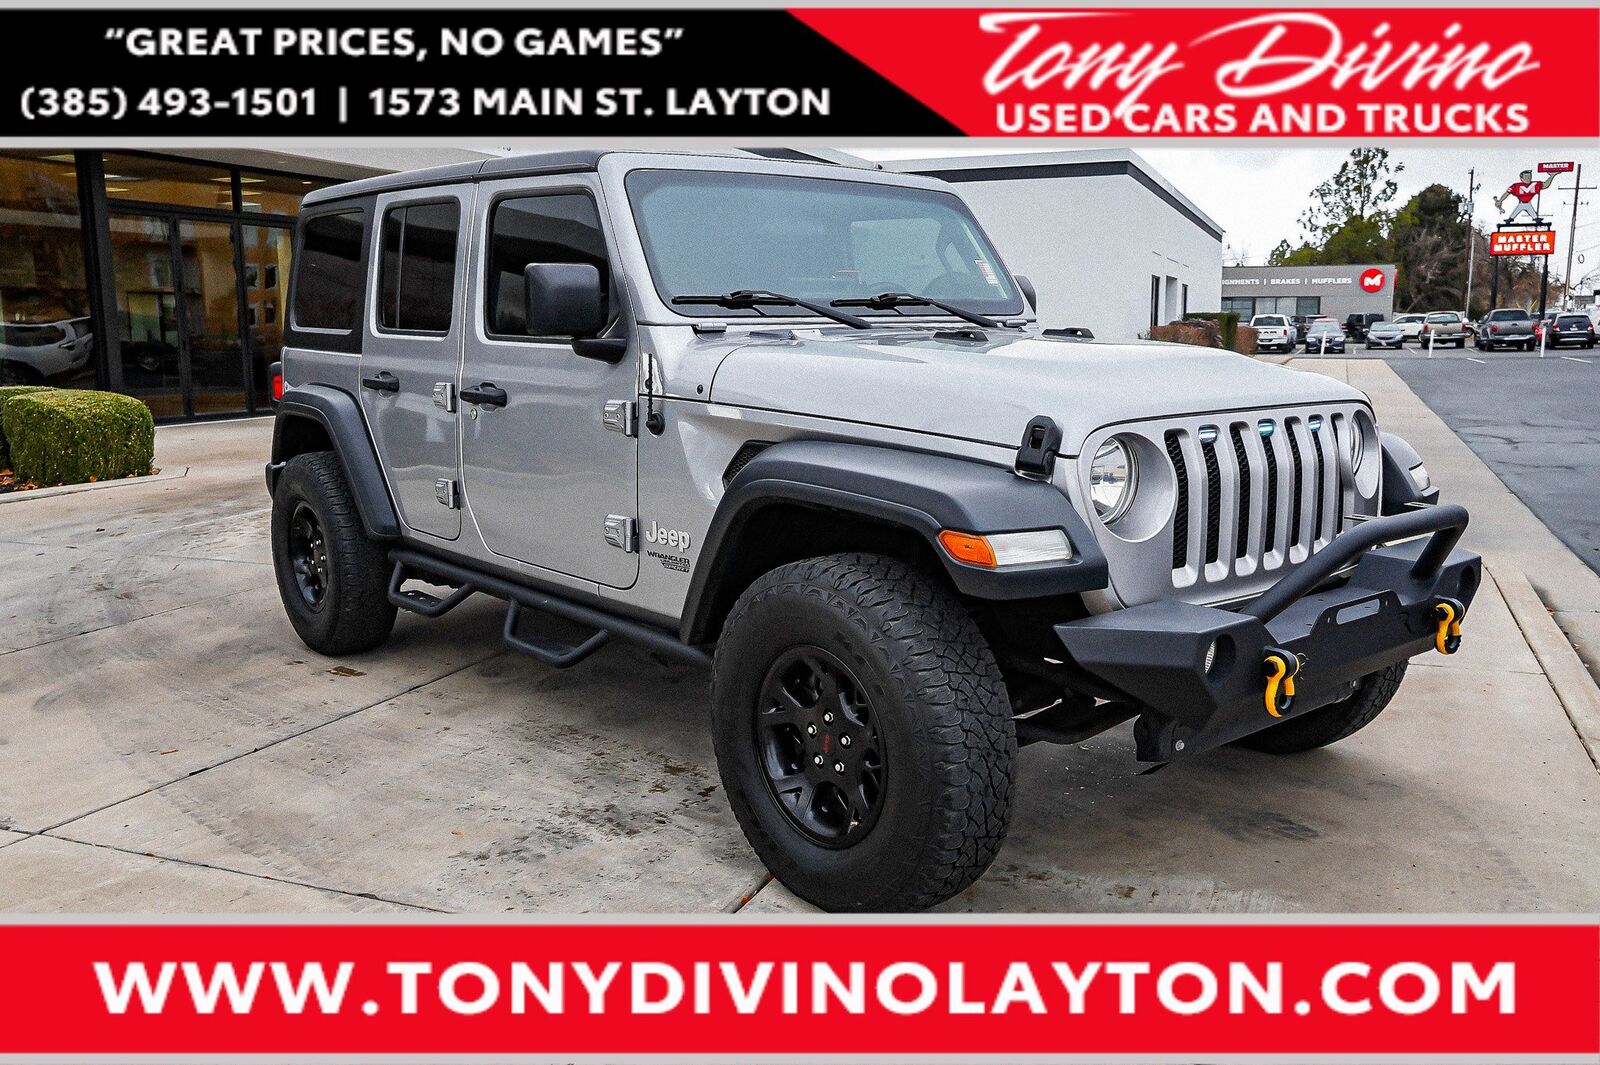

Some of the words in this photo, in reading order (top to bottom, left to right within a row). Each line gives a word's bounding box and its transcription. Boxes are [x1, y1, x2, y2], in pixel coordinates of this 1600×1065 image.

[1497, 234, 1548, 244] MASTER
[1493, 243, 1551, 252] MUFFLER
[1270, 277, 1301, 285] BRAKES
[1311, 277, 1353, 285] MUFFLERS
[645, 520, 691, 554] Jeep
[646, 550, 690, 564] WRANGLER
